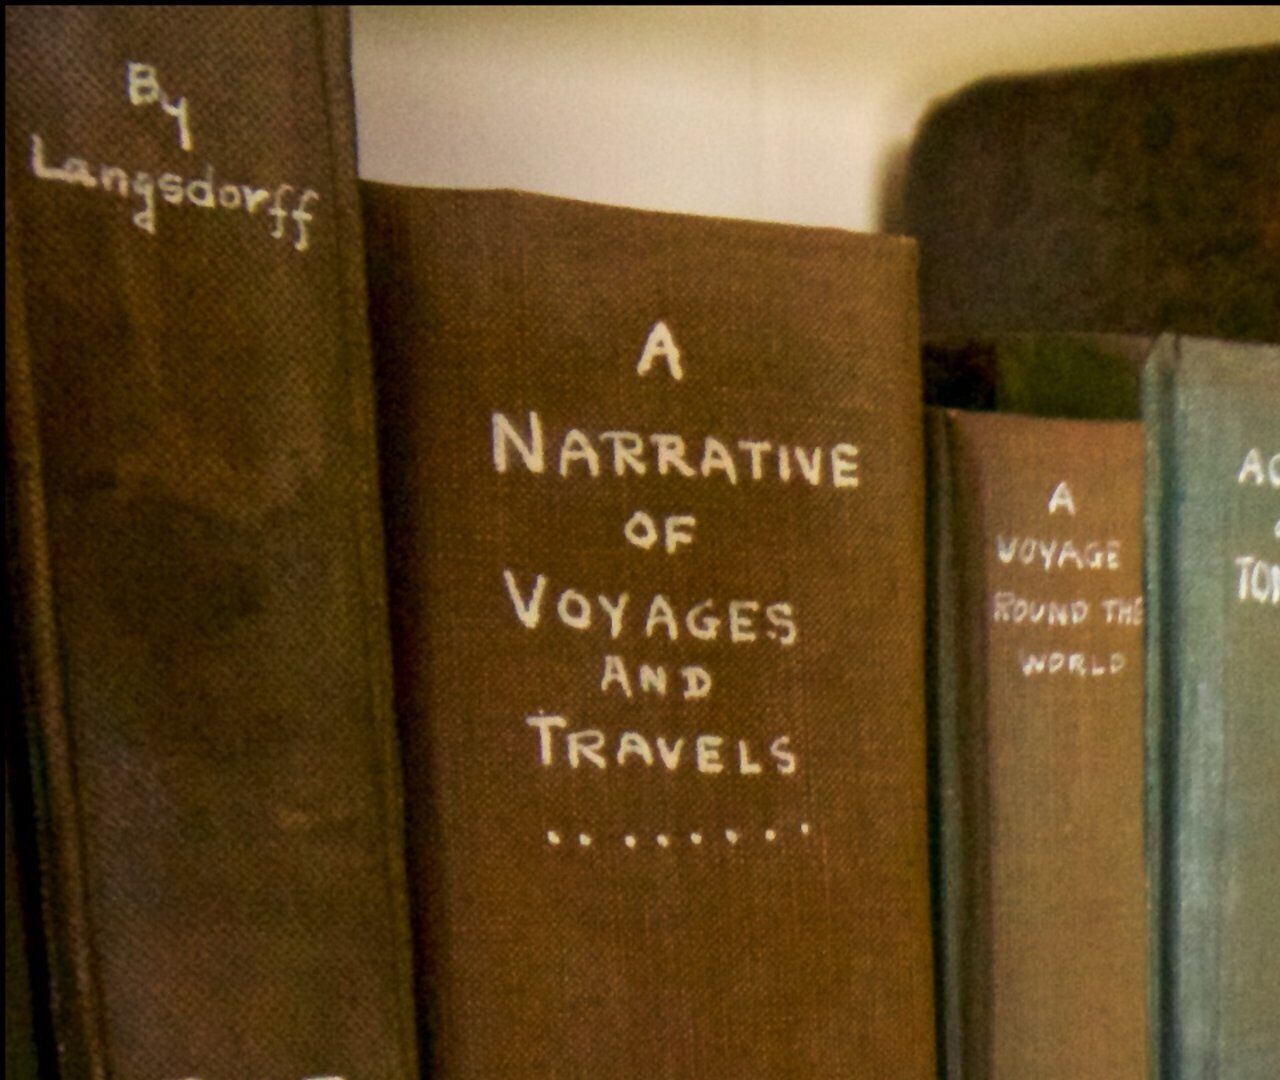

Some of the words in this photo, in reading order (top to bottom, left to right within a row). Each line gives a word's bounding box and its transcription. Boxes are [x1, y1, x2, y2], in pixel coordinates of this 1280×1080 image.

[127, 62, 193, 150] By
[30, 135, 320, 250] Langsdorff
[637, 322, 685, 381] A
[492, 411, 860, 489] NARRATIVE
[1048, 480, 1075, 516] A
[625, 511, 698, 554] OF
[997, 535, 1121, 570] VOYAGE
[504, 567, 797, 647] VOYAGES
[993, 592, 1088, 625] ROUND
[1104, 597, 1144, 625] THE
[600, 654, 711, 701] AND
[1022, 651, 1125, 677] WORLD
[526, 710, 797, 776] TRAVELS
